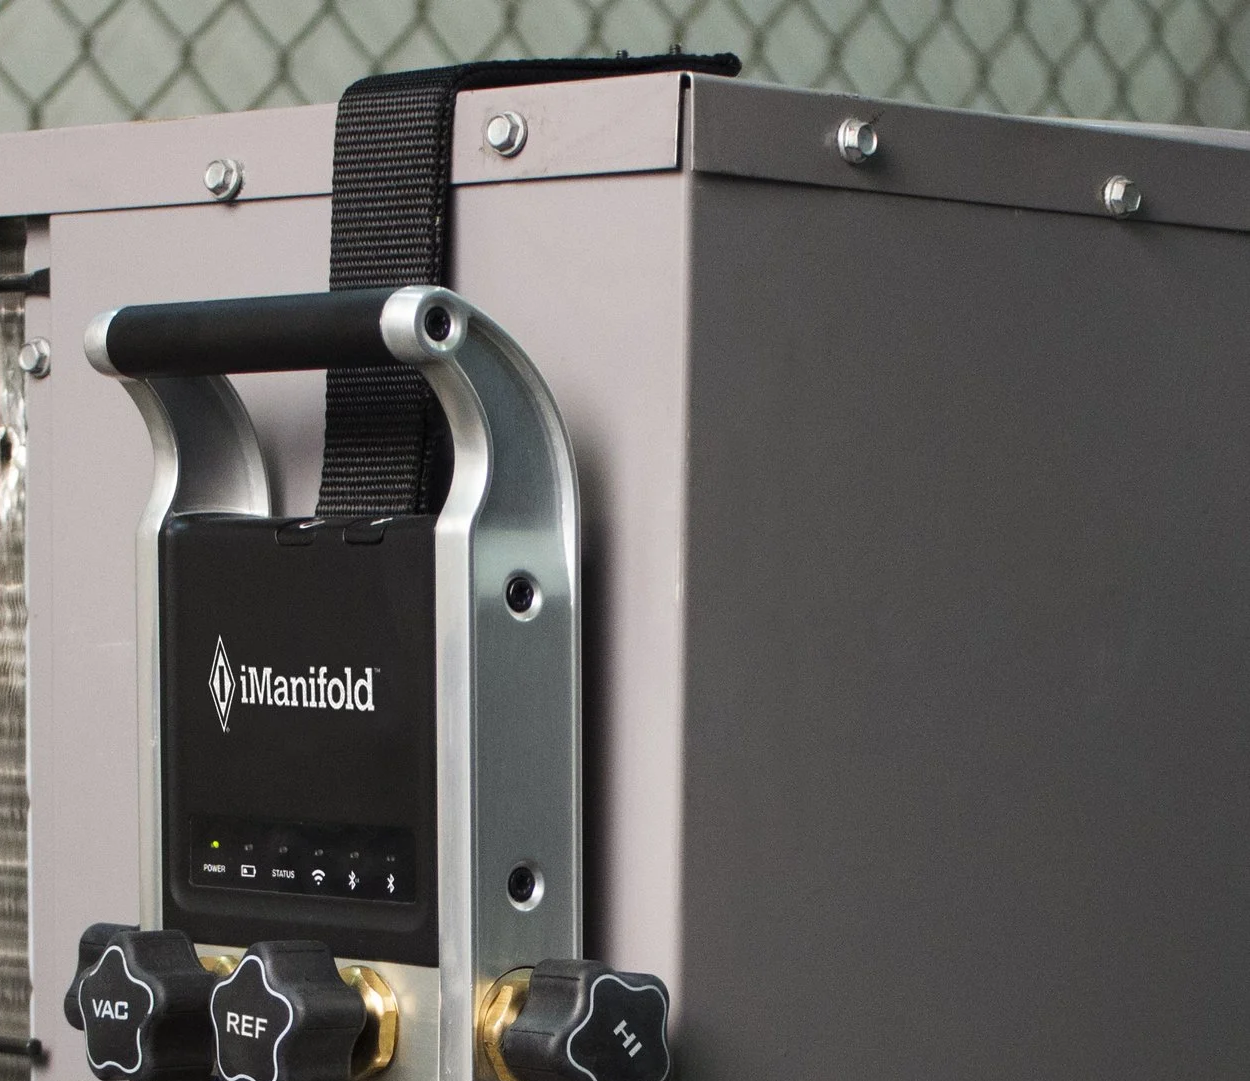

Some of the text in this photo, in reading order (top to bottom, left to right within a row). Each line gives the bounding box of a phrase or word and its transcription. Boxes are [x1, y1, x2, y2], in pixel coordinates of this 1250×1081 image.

[240, 665, 375, 712] iManifold
[203, 863, 226, 873] POWER
[271, 868, 295, 879] STATUS
[91, 999, 129, 1021] VAC
[226, 1011, 269, 1040] REF
[613, 1019, 643, 1059] HI
